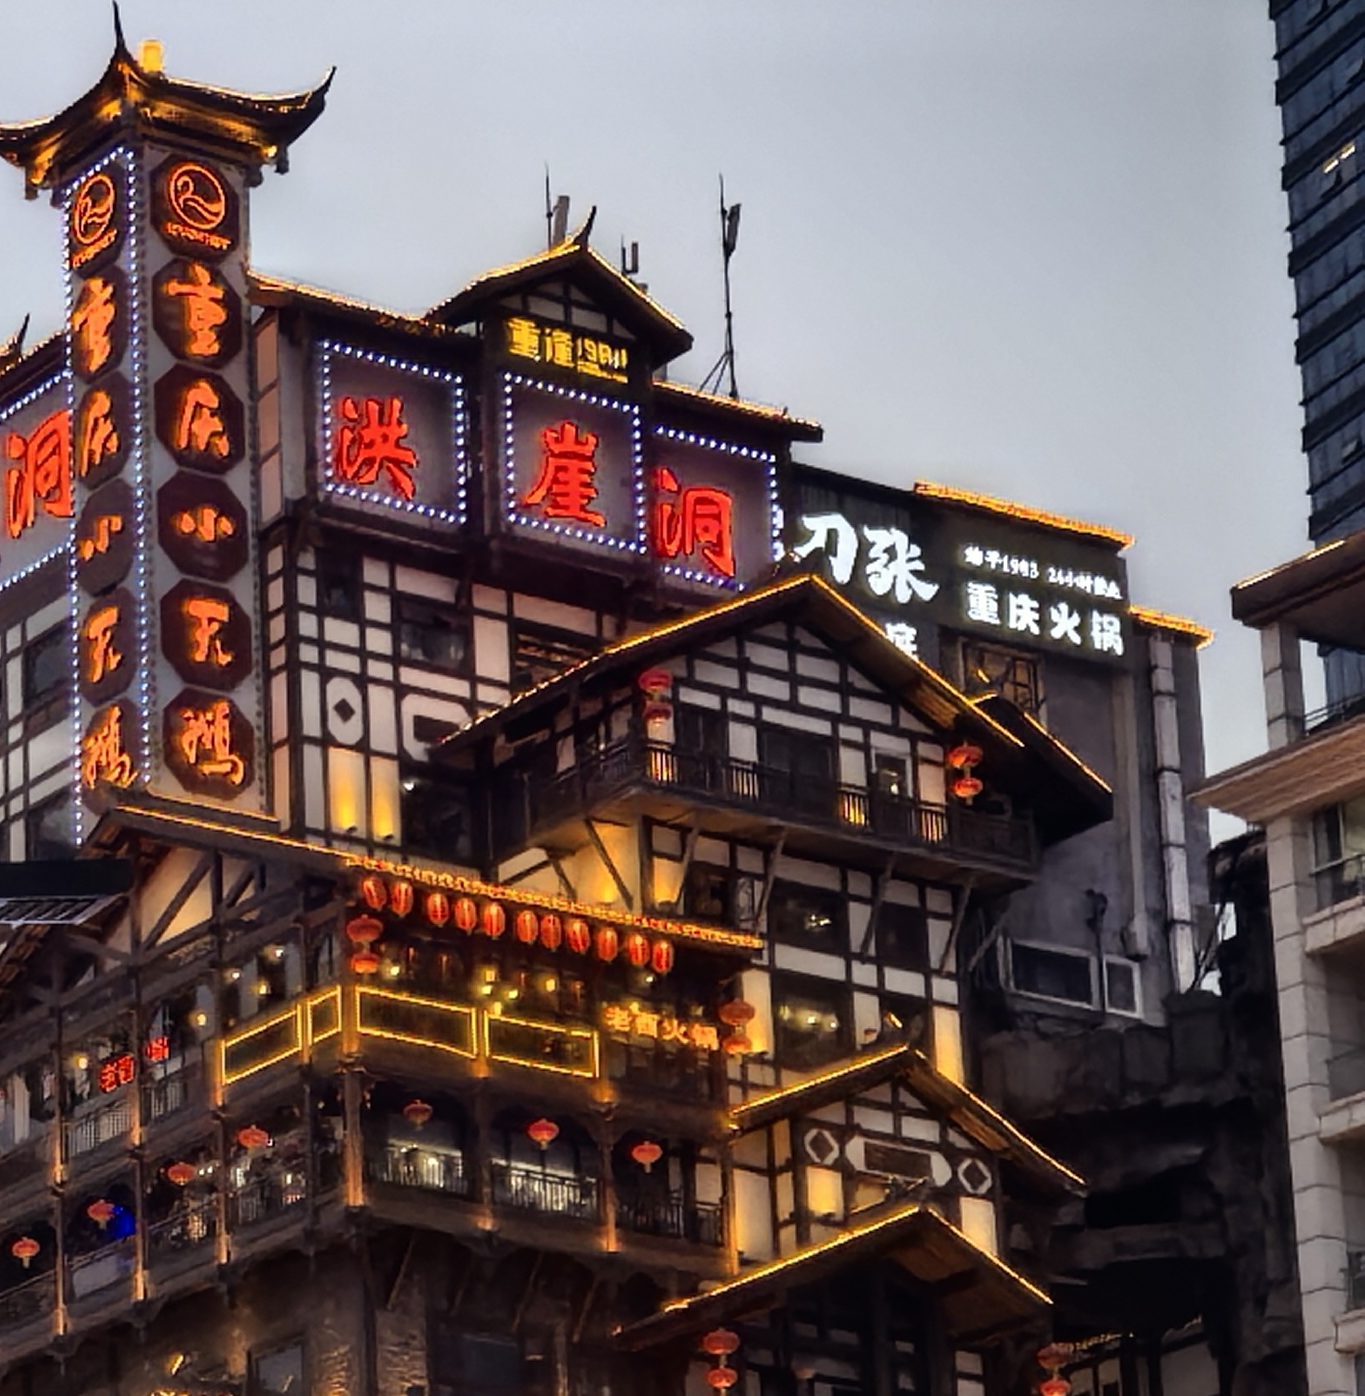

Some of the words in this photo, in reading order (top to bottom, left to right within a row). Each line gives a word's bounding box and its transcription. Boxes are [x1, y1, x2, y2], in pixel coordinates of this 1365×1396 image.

[335, 396, 735, 578] 洪崖洞
[968, 582, 1124, 656] 重庆火锅
